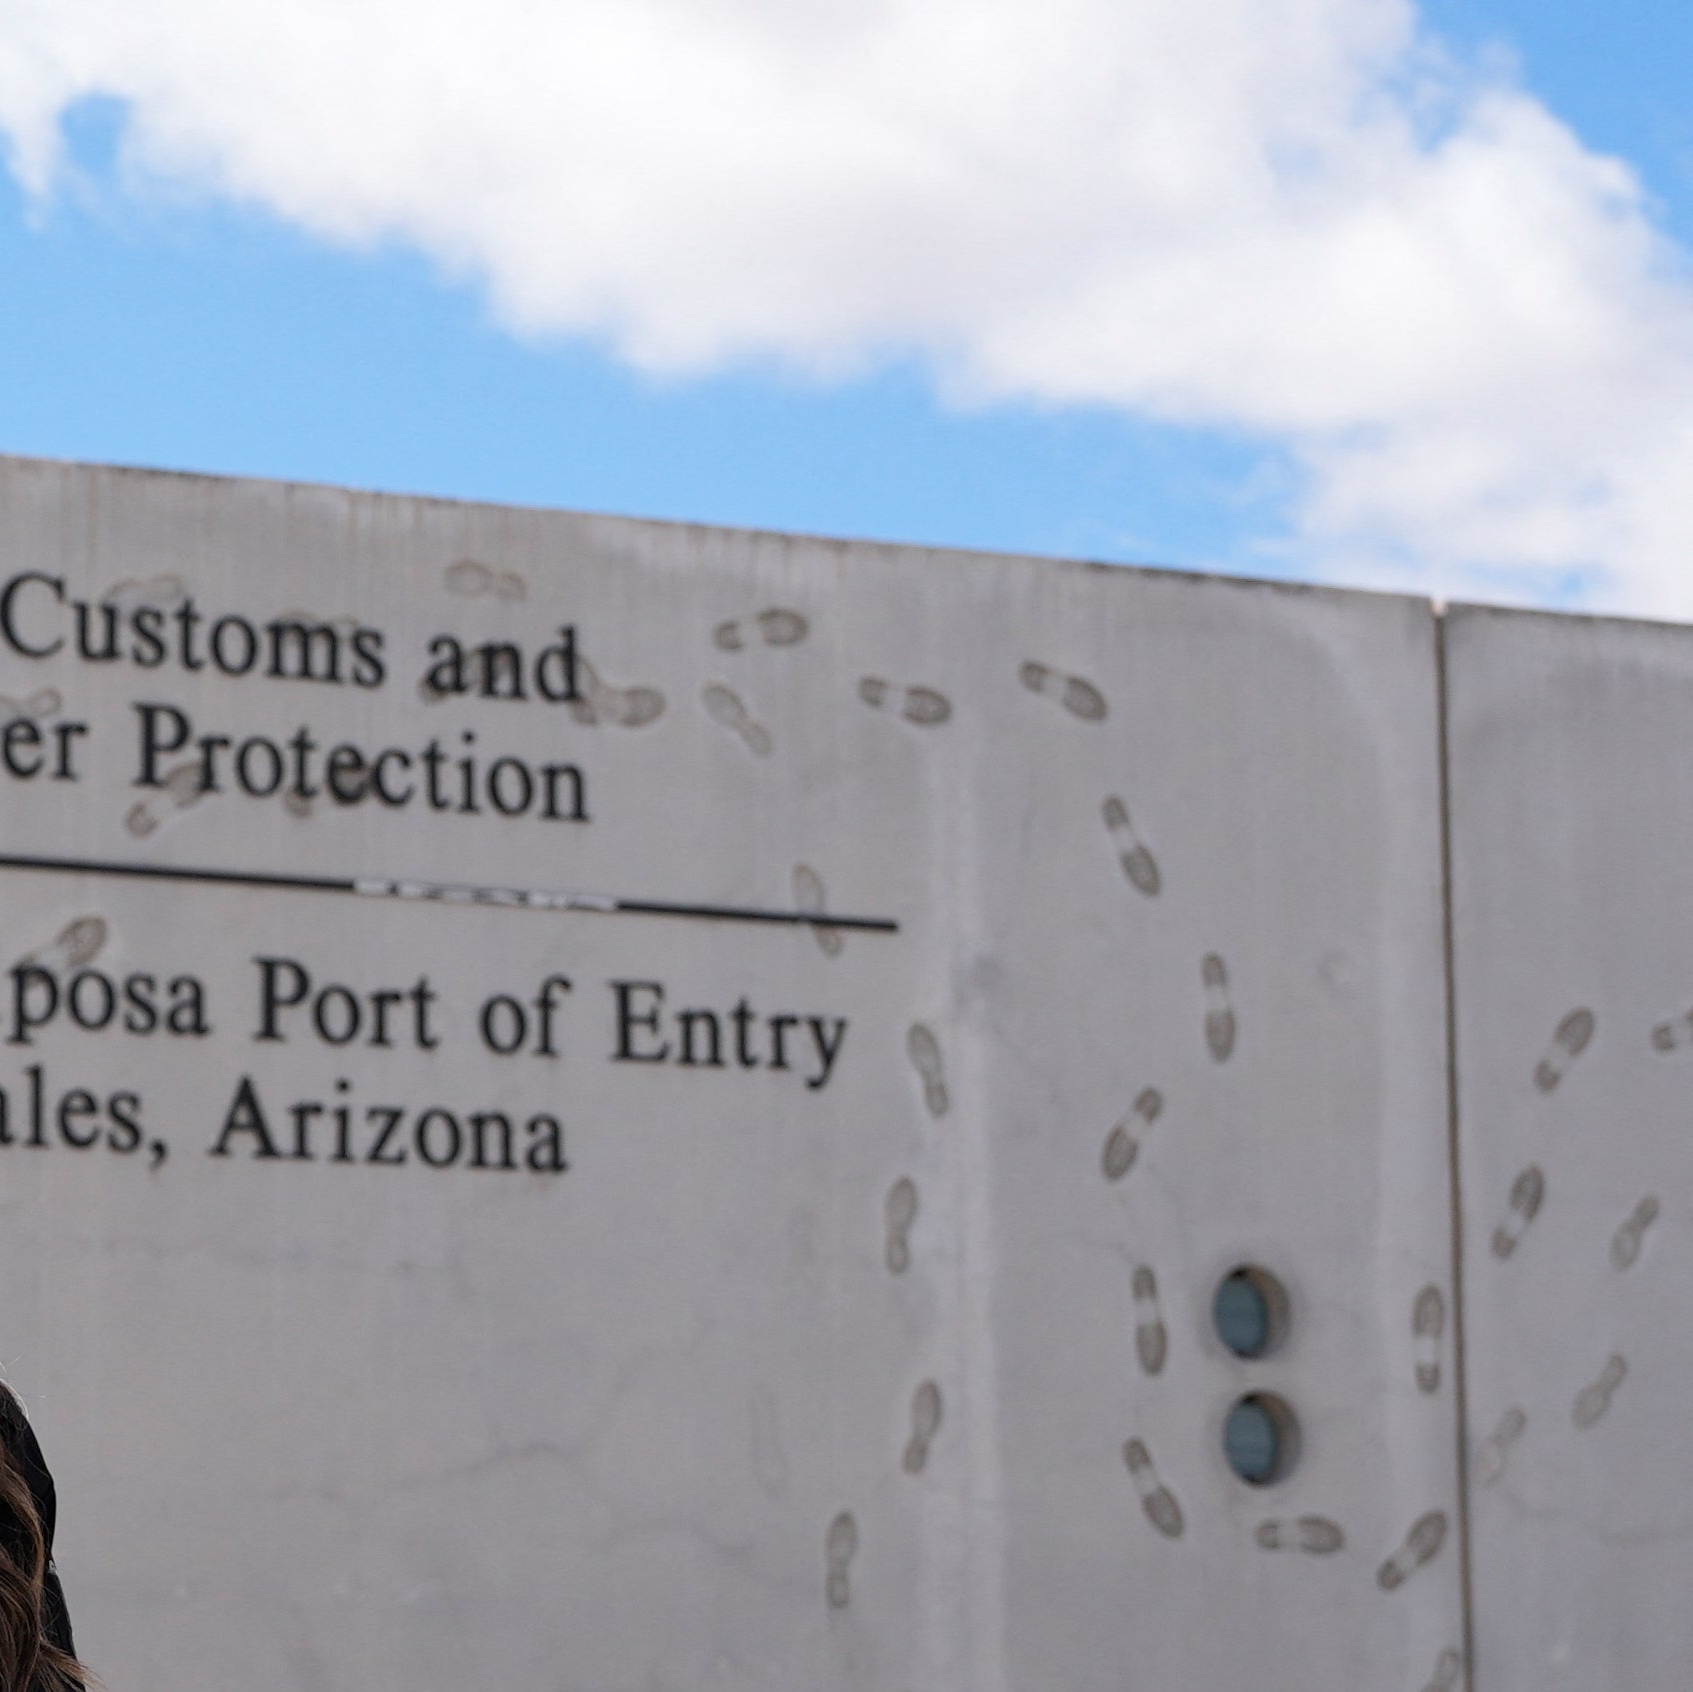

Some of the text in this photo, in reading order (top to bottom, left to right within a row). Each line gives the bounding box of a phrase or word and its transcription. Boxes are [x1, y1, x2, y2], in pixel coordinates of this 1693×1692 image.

[426, 626, 585, 703] and
[131, 698, 592, 822] Protection
[253, 955, 441, 1052] Port
[478, 976, 575, 1059] of
[609, 978, 848, 1092] Entry
[211, 1074, 570, 1174] Arizona
